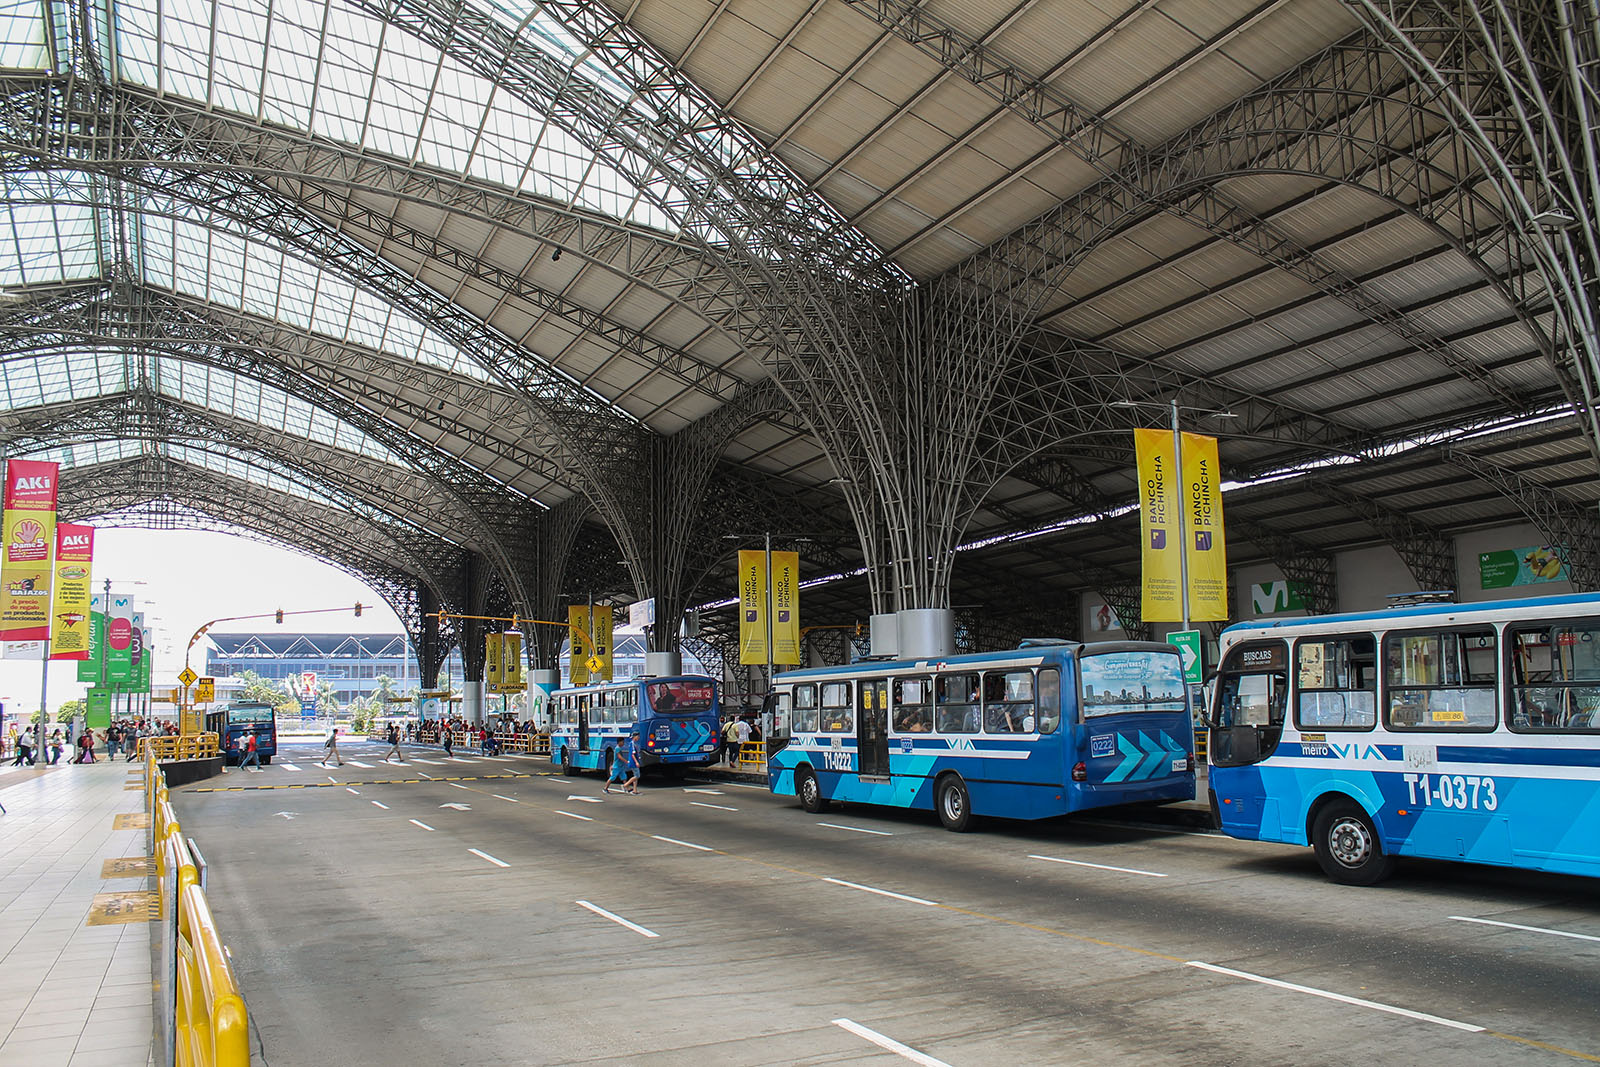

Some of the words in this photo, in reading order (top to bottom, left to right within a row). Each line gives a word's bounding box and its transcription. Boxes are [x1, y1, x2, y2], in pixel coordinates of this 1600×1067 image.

[1154, 456, 1165, 524] PICHINCHA
[1199, 459, 1211, 526] PICHINCHA
[1147, 480, 1157, 523] BANCO
[1192, 482, 1202, 525] BANCO
[12, 541, 36, 549] Dame
[36, 538, 45, 548] 5
[132, 639, 141, 653] 3
[1244, 650, 1272, 661] BUSCARS
[947, 739, 975, 750] VIA
[1093, 740, 1113, 751] 0222
[1302, 745, 1328, 756] metro
[1332, 744, 1383, 759] VIA
[824, 752, 852, 771] T1-0222
[1403, 773, 1498, 811] T1-0373
